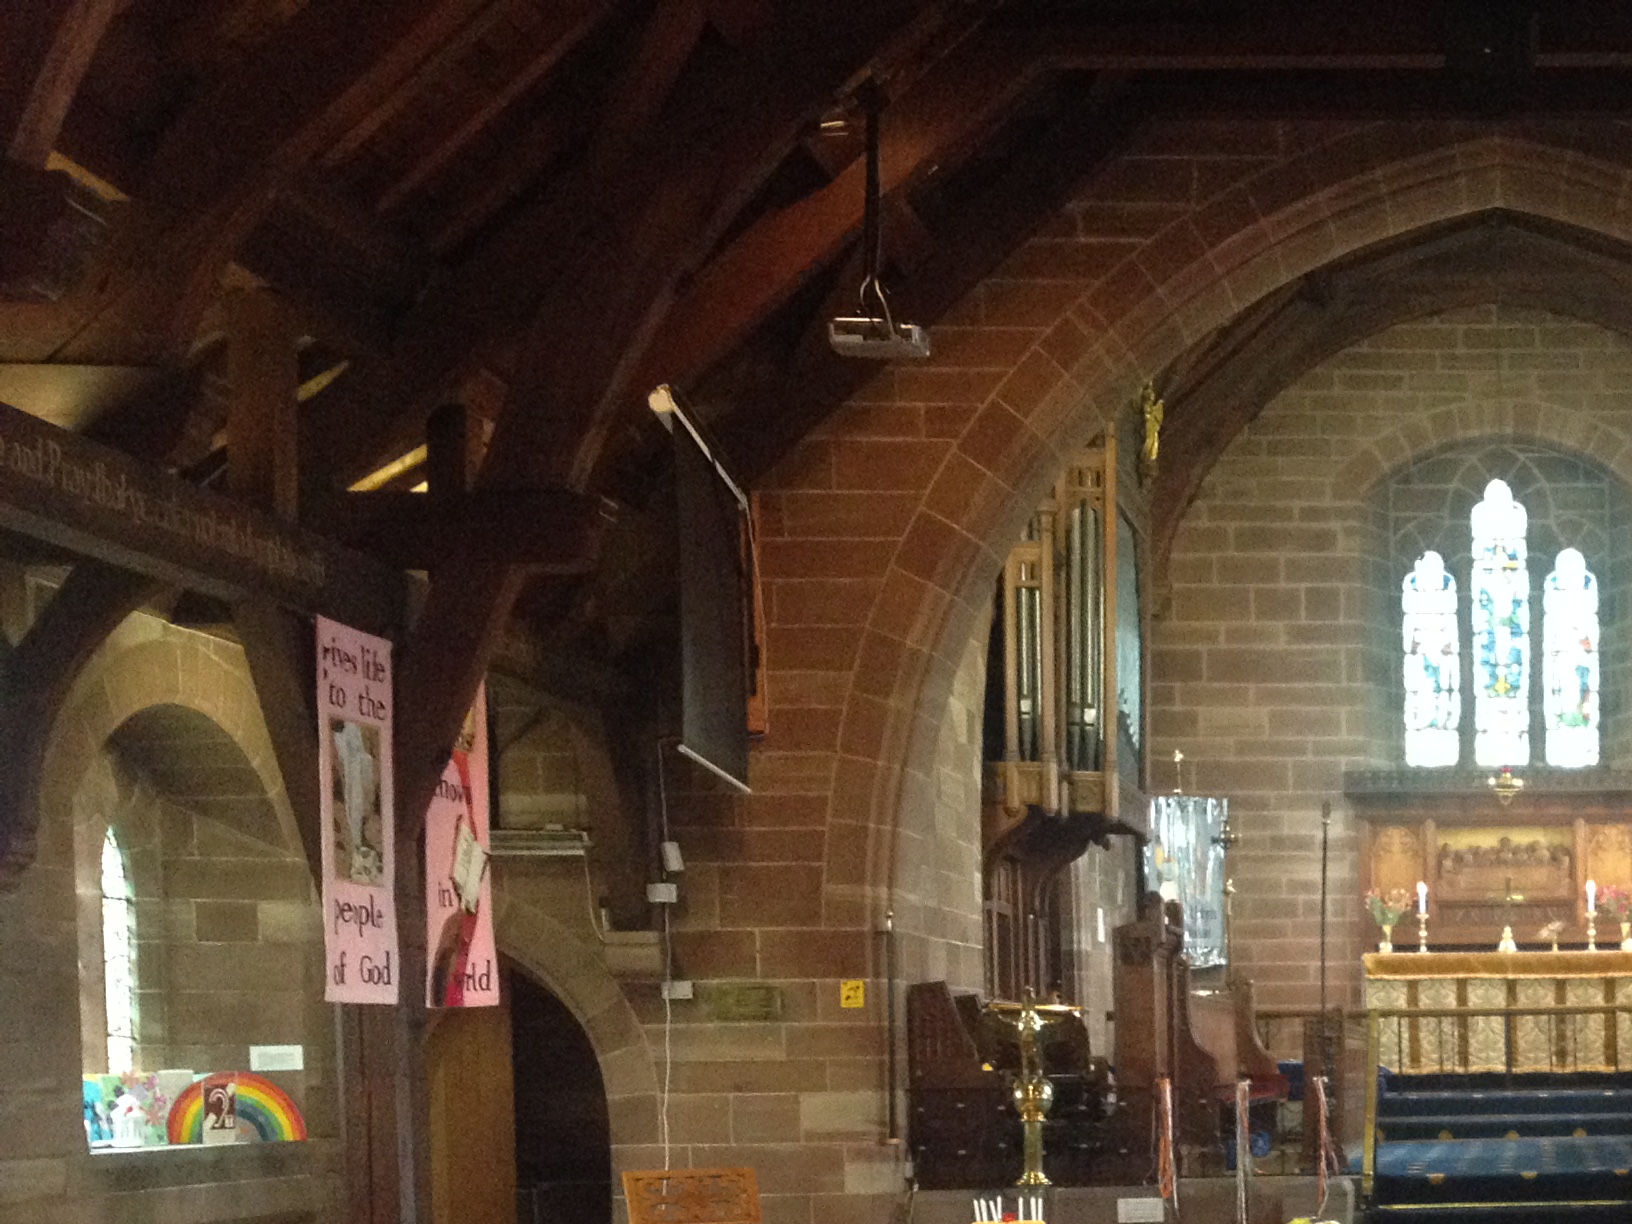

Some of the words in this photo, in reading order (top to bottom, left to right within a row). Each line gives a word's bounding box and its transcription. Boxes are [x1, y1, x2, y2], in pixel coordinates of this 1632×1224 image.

[329, 682, 347, 709] to
[358, 684, 386, 720] the
[438, 881, 454, 908] in
[333, 894, 384, 938] people
[333, 950, 347, 986] of
[359, 950, 392, 986] God
